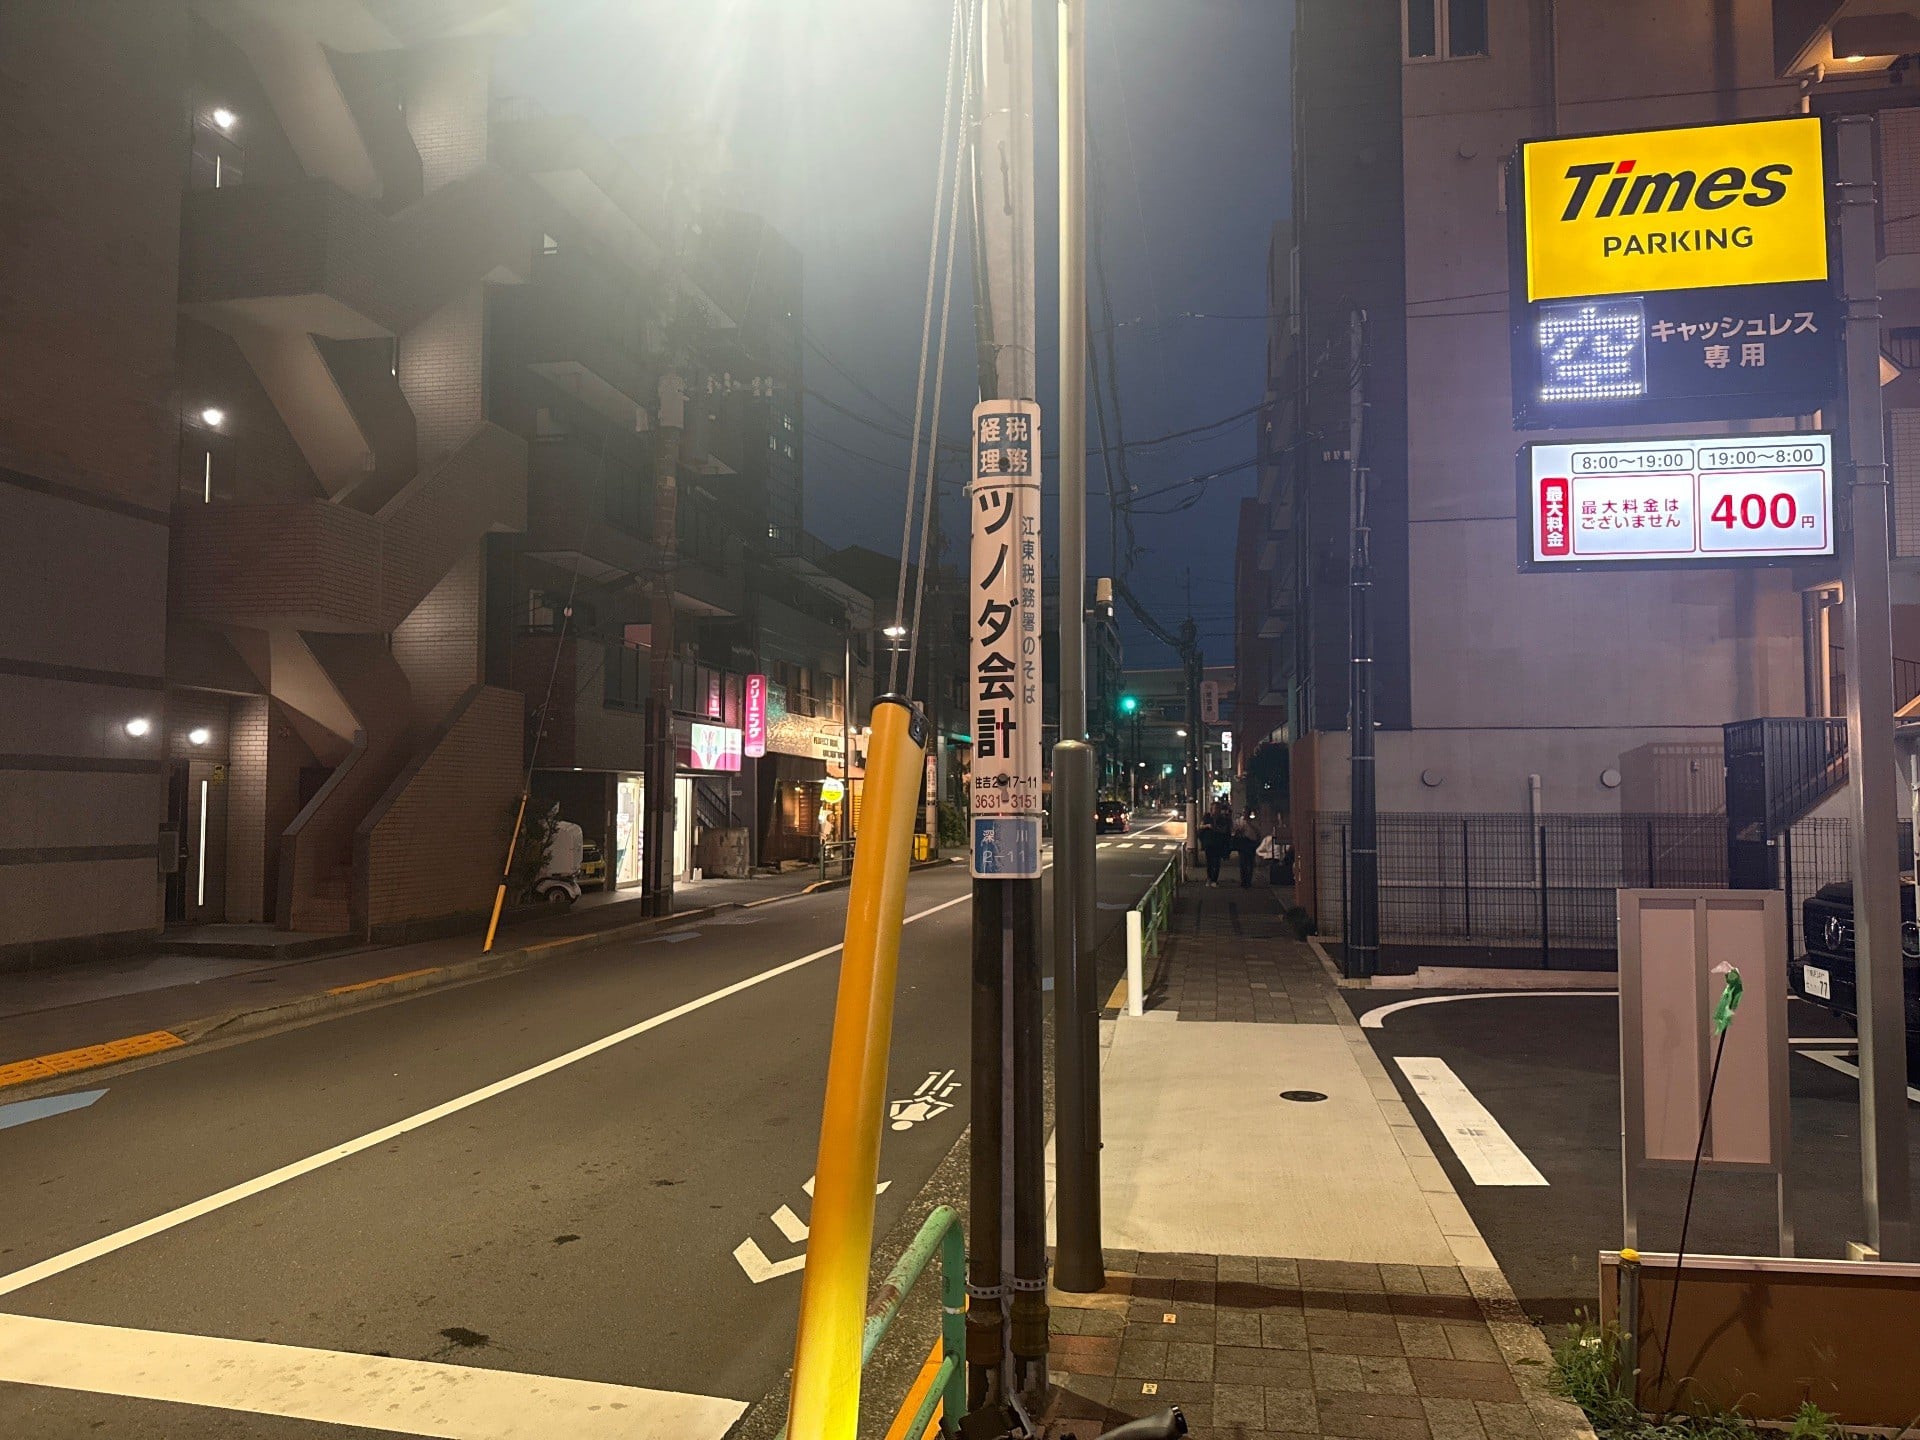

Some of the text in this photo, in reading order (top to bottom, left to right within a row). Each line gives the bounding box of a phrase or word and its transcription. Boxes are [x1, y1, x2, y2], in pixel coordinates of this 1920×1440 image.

[1560, 160, 1793, 222] Times
[1603, 226, 1754, 258] PARKING
[1539, 307, 1641, 401] 空
[1651, 312, 1818, 343] キャッシュレス
[1703, 342, 1766, 369] 専用
[980, 417, 1001, 473] 経理
[1546, 486, 1564, 548] 最大料金
[1581, 498, 1680, 515] 最大料金は
[1581, 515, 1681, 531] ございません
[978, 491, 1019, 759] ツノダ会計
[1022, 516, 1036, 705] 江東税務署のそば
[749, 678, 761, 738] クリーニング
[975, 776, 1037, 789] 住吉217-11
